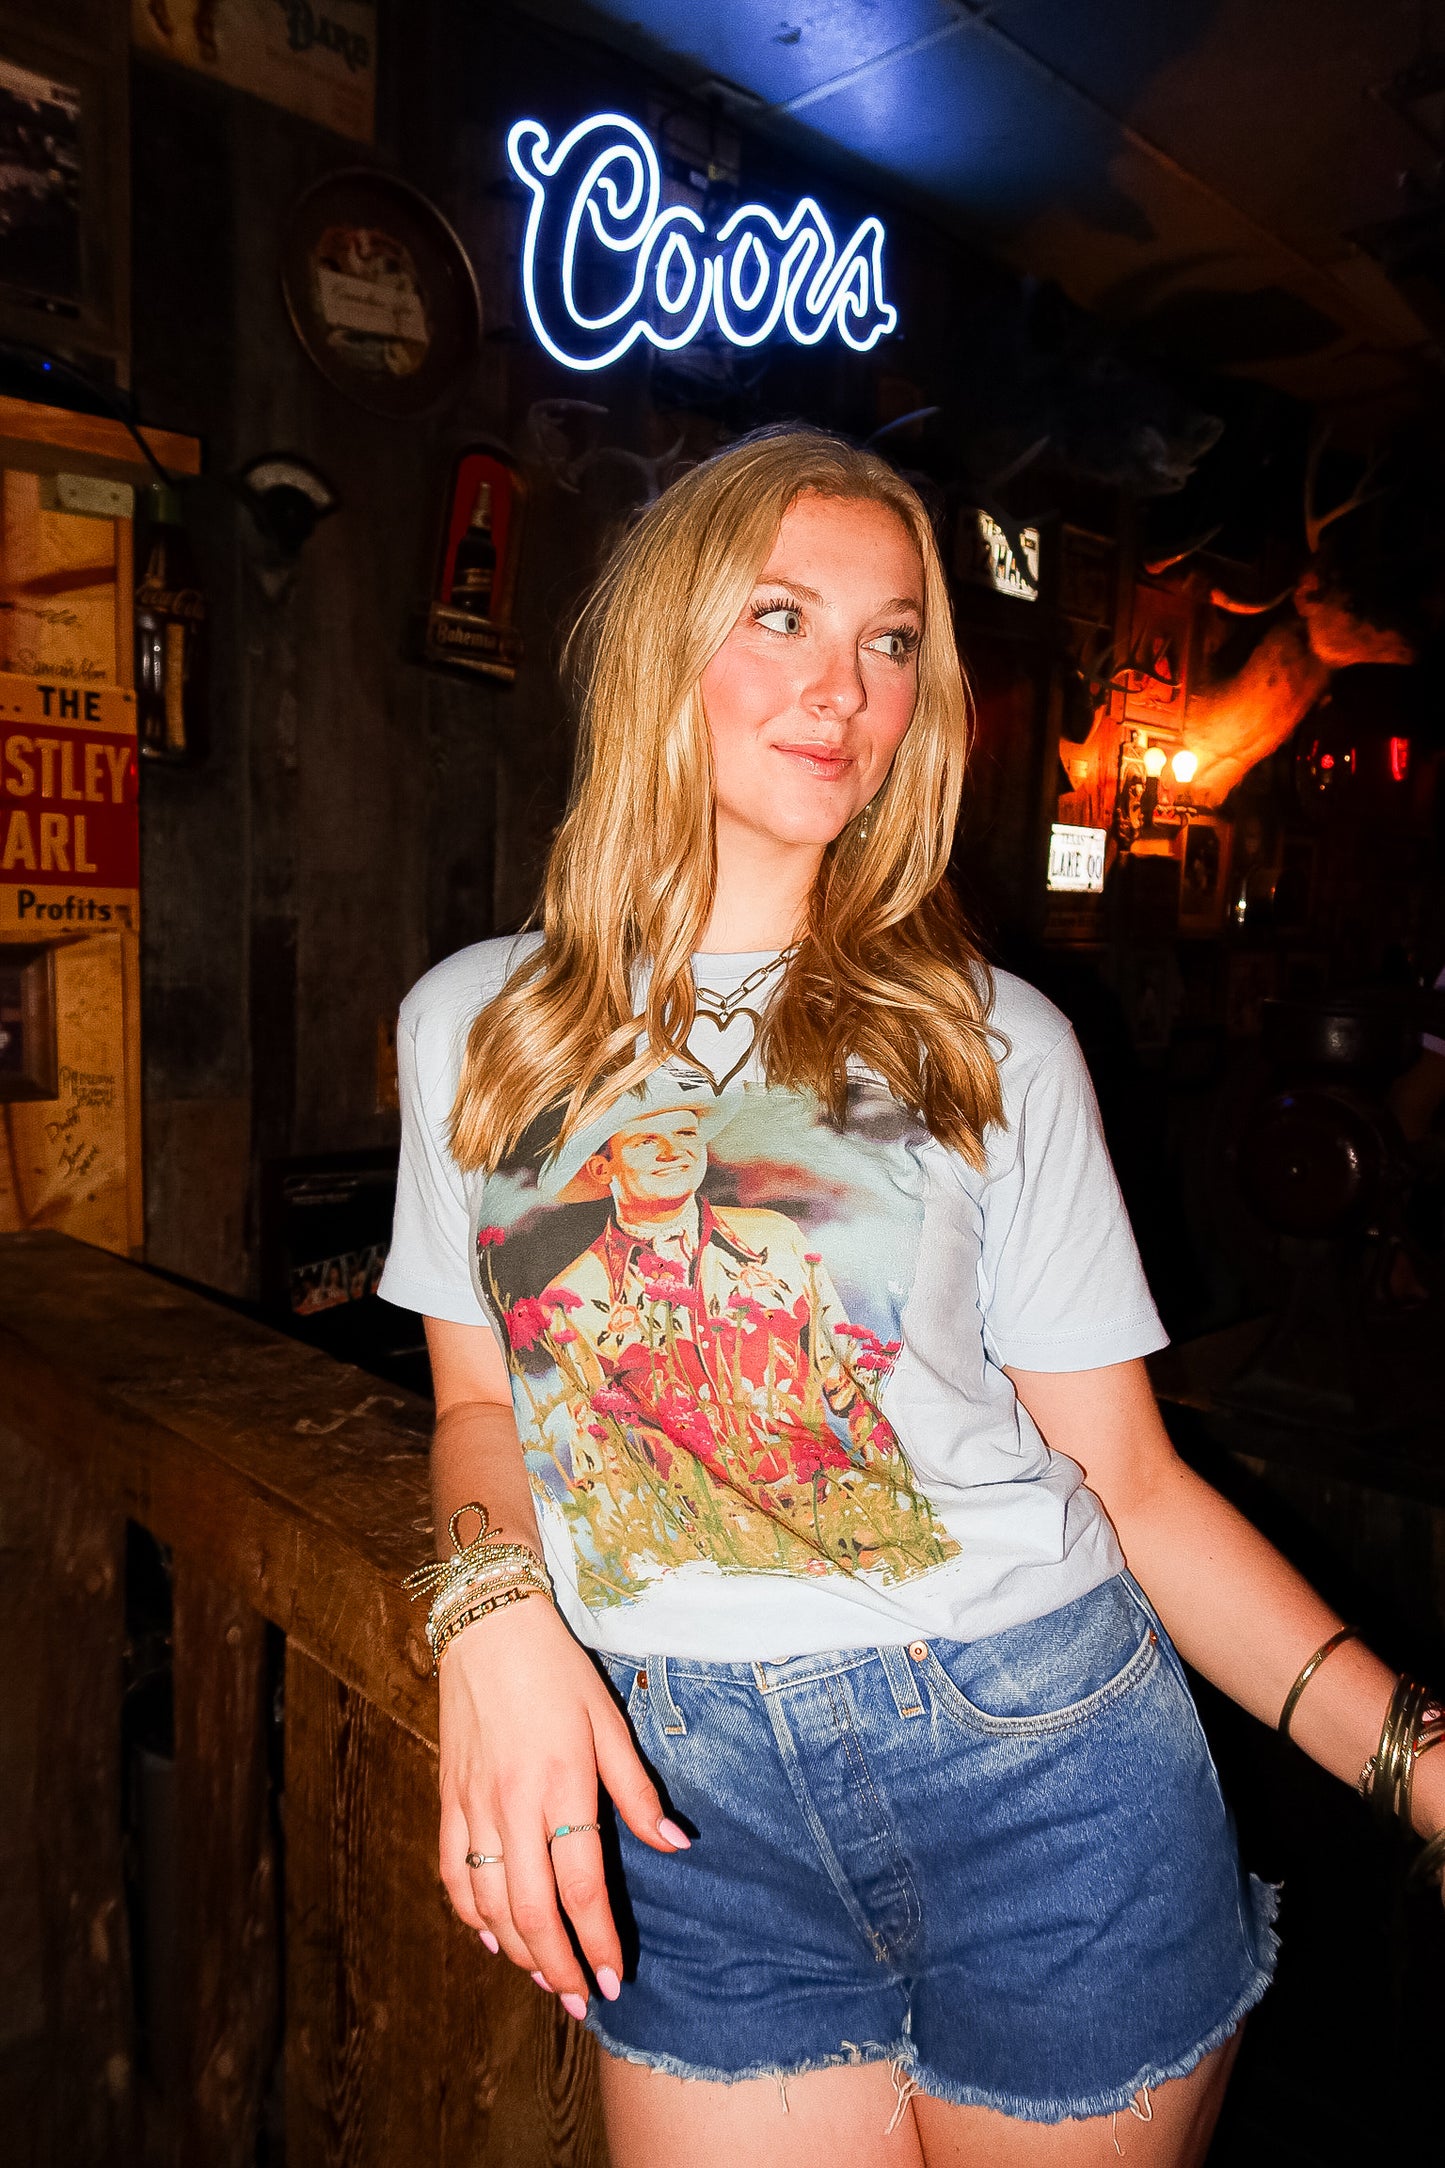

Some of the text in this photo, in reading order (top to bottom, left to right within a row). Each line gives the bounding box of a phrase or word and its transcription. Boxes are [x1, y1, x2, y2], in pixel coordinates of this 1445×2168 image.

[507, 113, 898, 371] Coors
[36, 684, 102, 722] THE
[0, 734, 131, 804] STLEY
[0, 810, 97, 873] ARL
[17, 888, 112, 922] Profits
